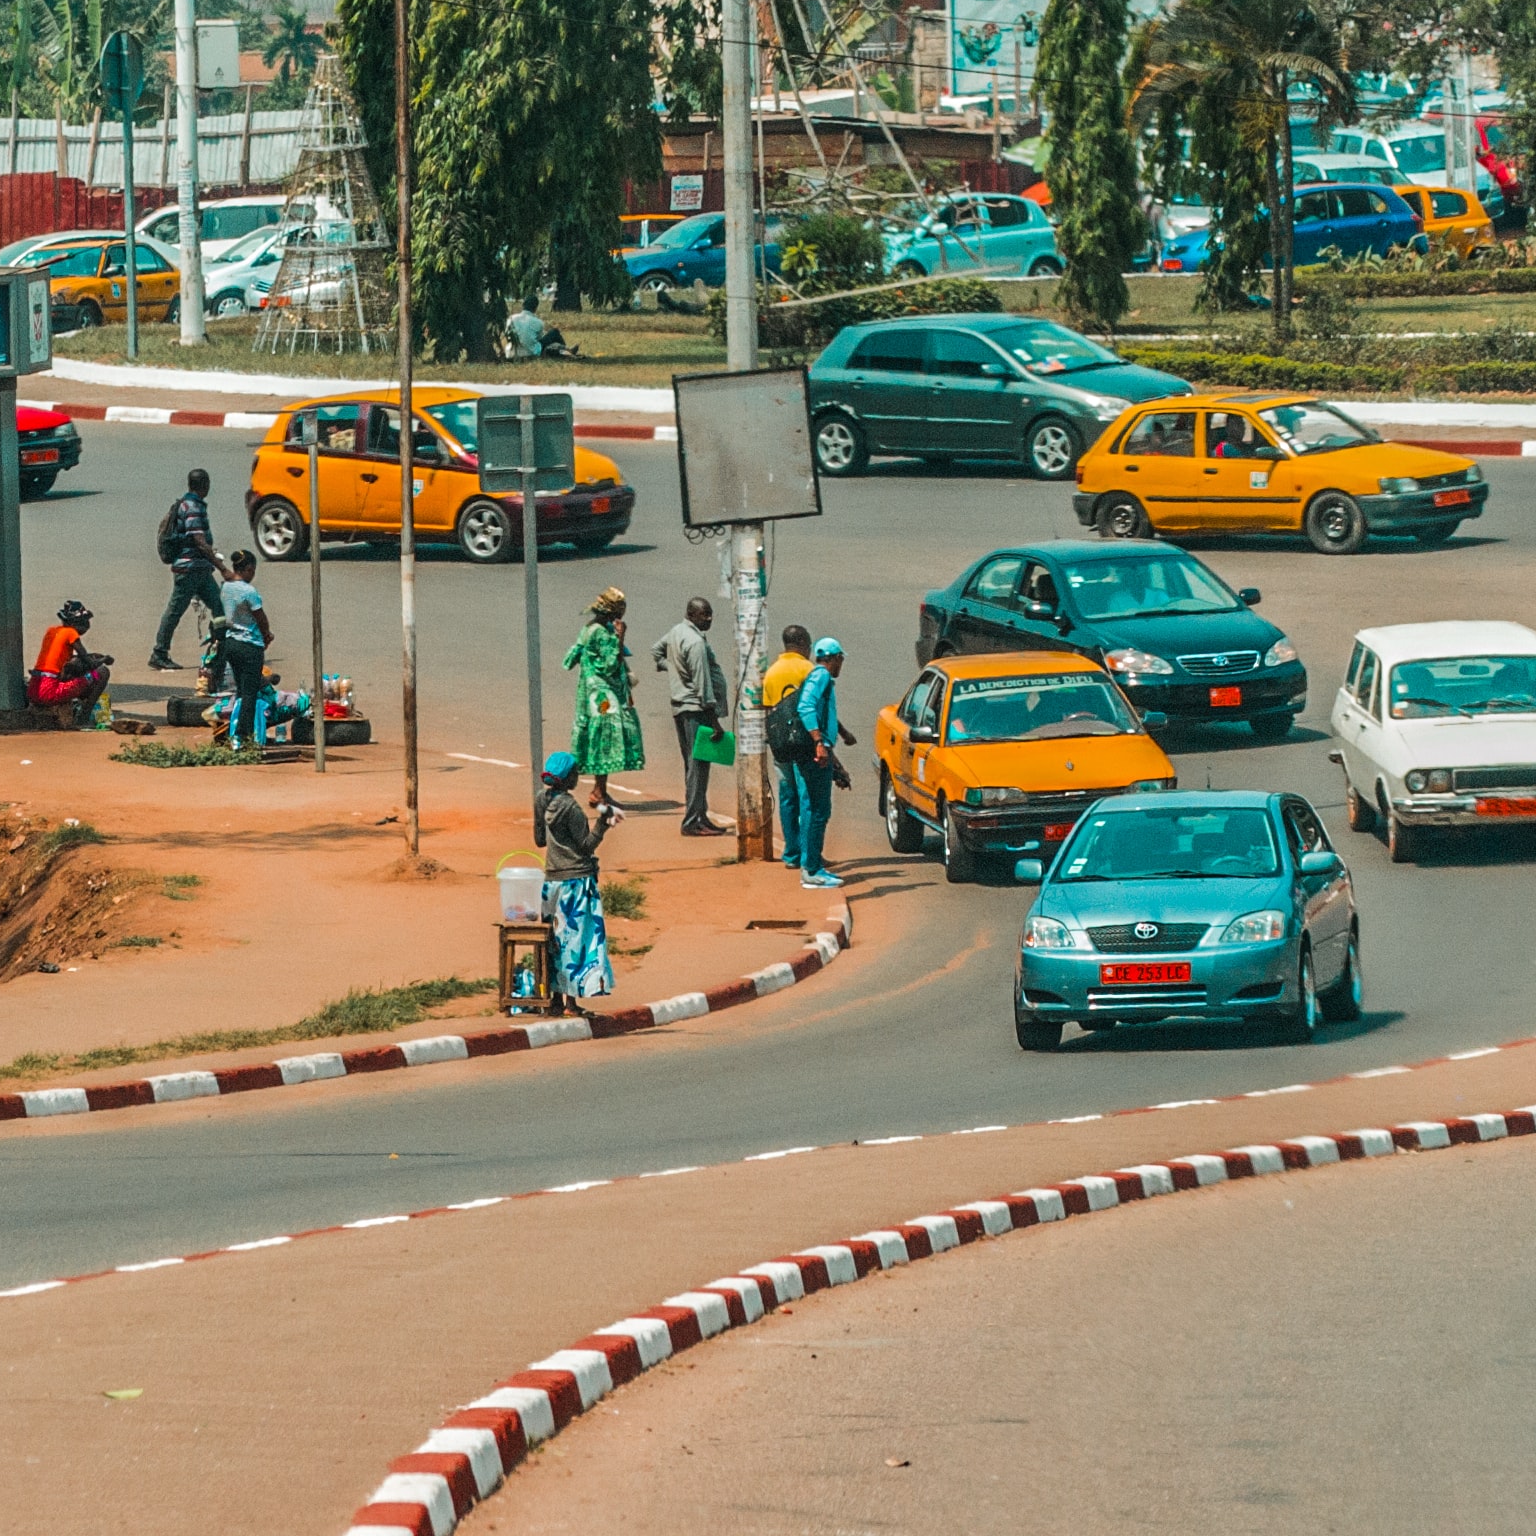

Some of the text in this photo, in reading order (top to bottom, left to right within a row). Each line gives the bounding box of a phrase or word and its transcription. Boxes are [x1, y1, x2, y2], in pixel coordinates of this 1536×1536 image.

[960, 675, 1093, 694] LA BENEDICTION DE DIEU
[1115, 966, 1183, 981] CE 253 LC
